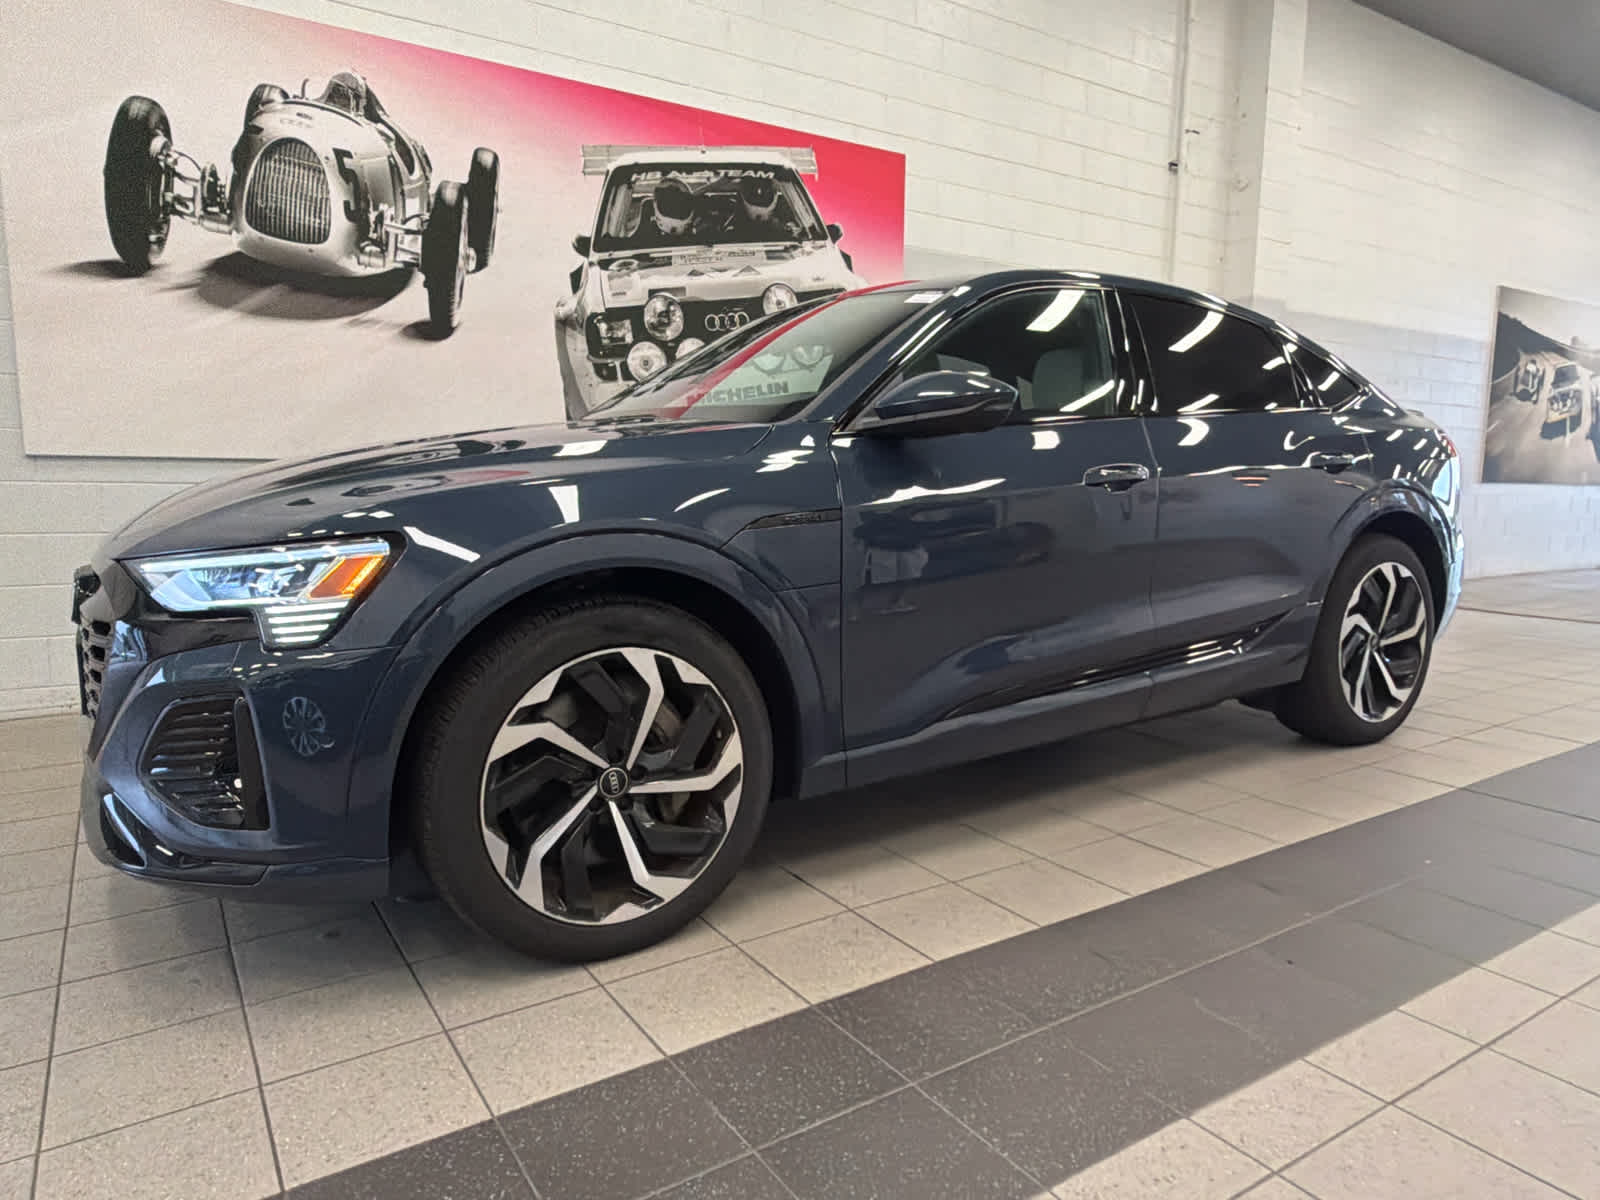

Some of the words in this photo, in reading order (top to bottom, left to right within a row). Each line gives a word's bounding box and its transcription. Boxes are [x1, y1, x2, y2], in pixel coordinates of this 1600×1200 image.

[332, 147, 363, 224] 5
[631, 170, 662, 181] HB
[717, 168, 775, 179] TEAM
